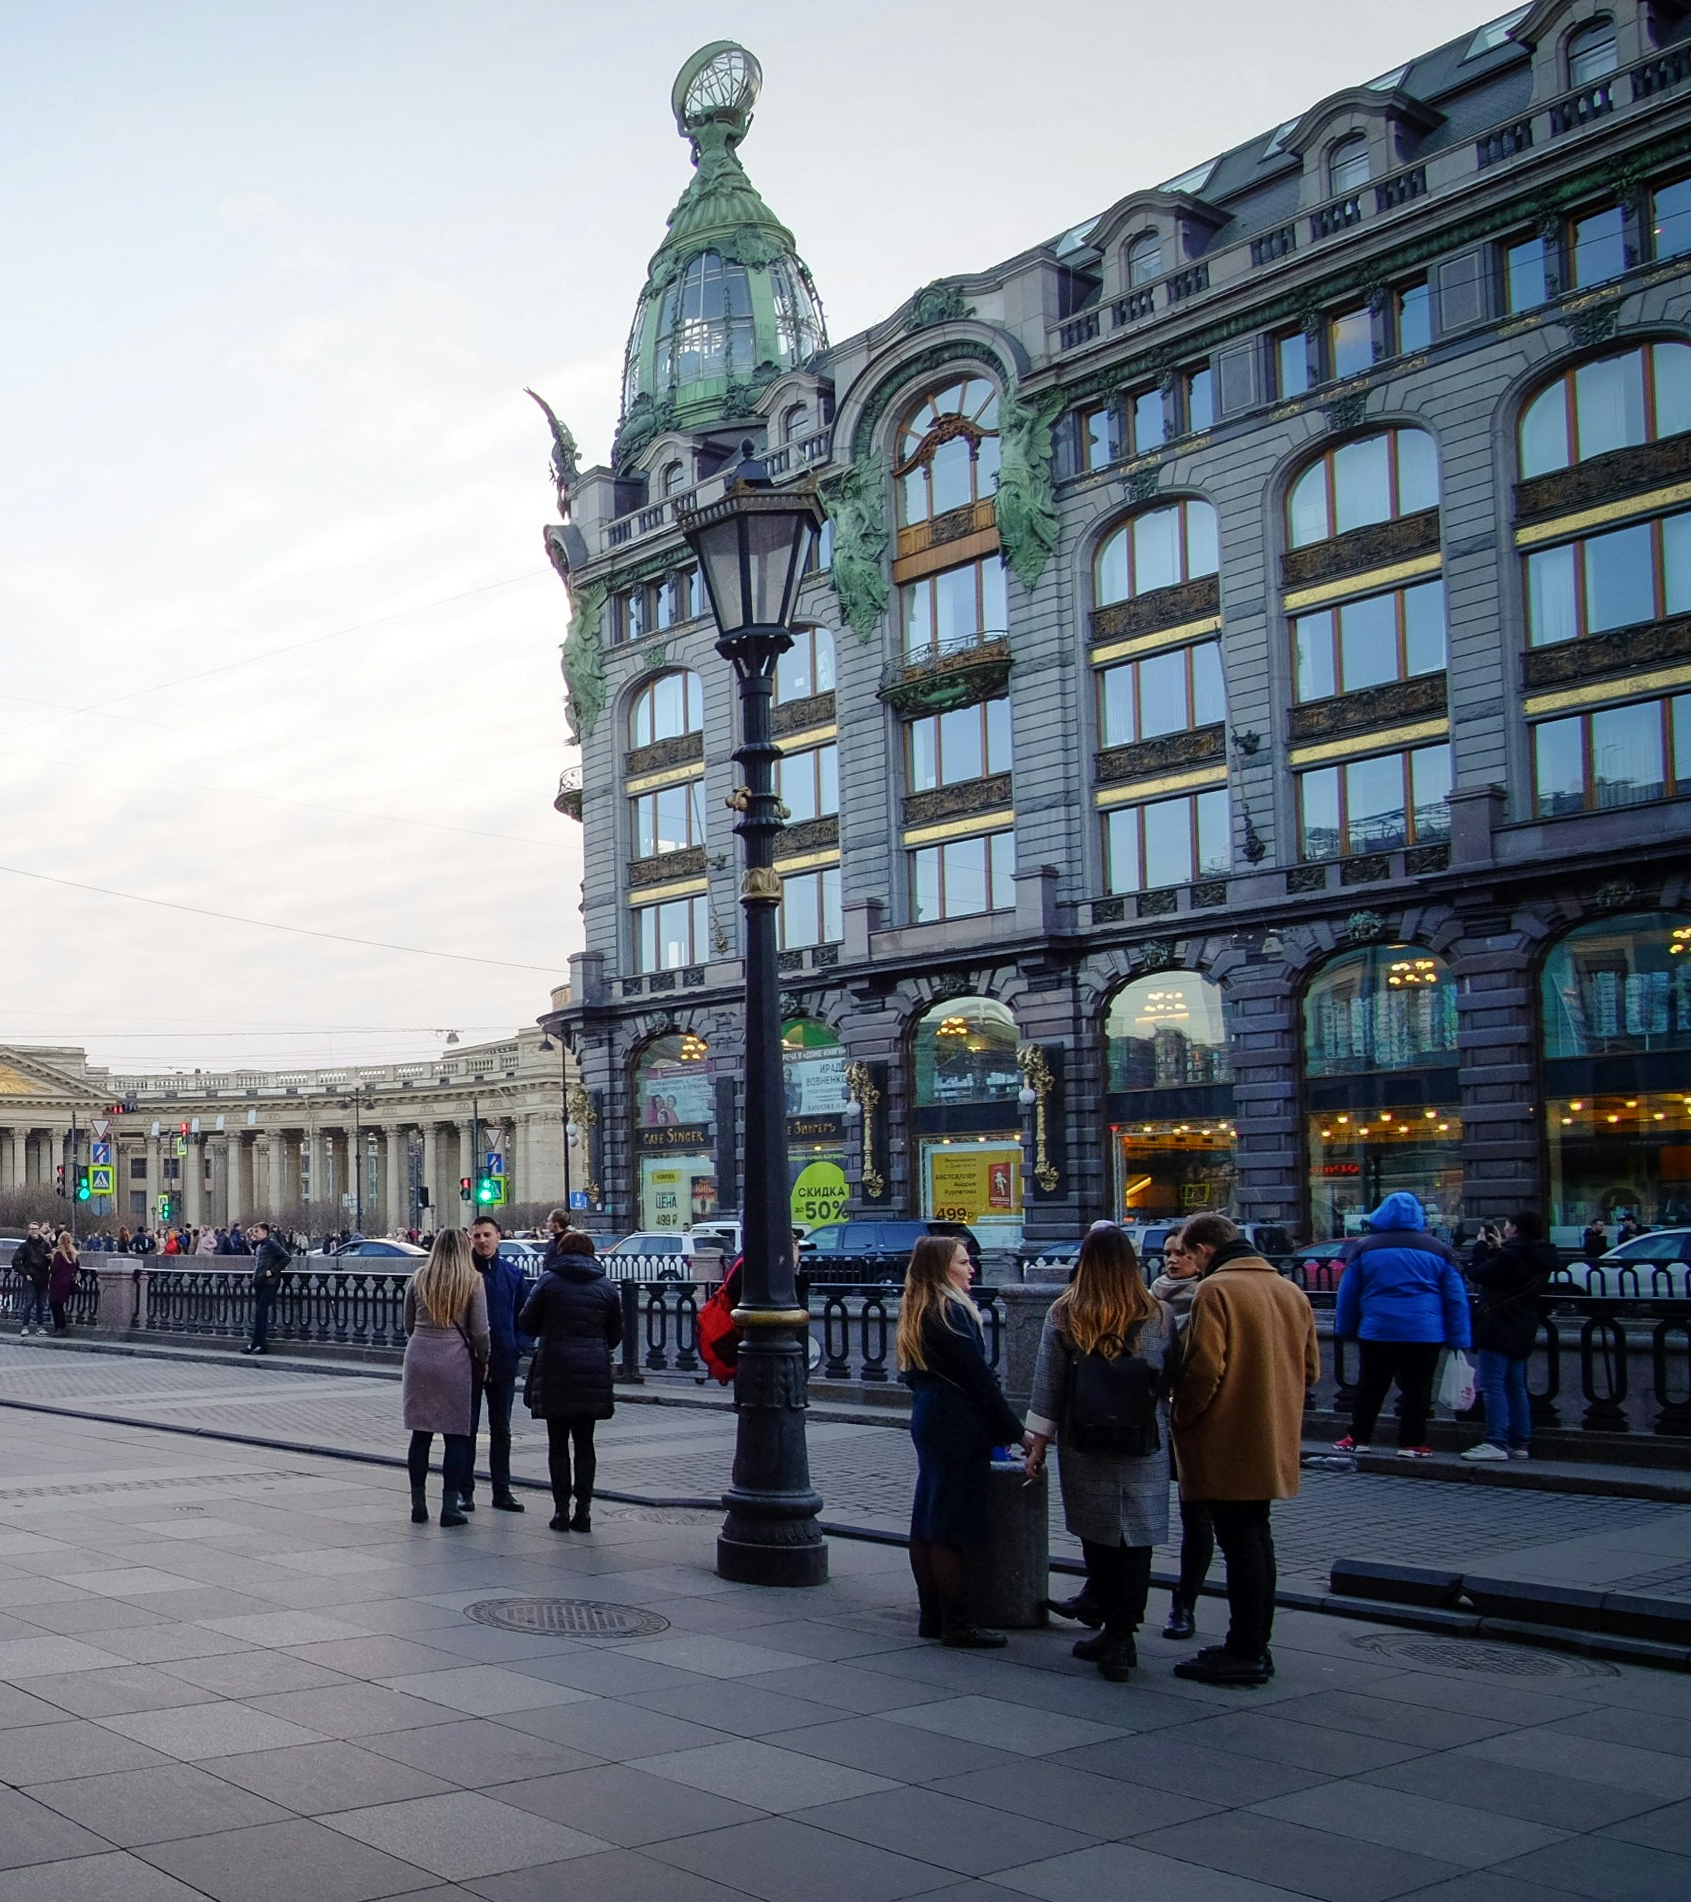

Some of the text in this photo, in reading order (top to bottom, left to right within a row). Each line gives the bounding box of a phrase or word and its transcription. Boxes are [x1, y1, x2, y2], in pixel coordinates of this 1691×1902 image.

[798, 1186, 845, 1198] СКИДКА
[655, 1196, 677, 1209] ЦЕНА
[805, 1200, 849, 1220] 50%
[935, 1207, 967, 1221] 499
[656, 1214, 671, 1227] 499
